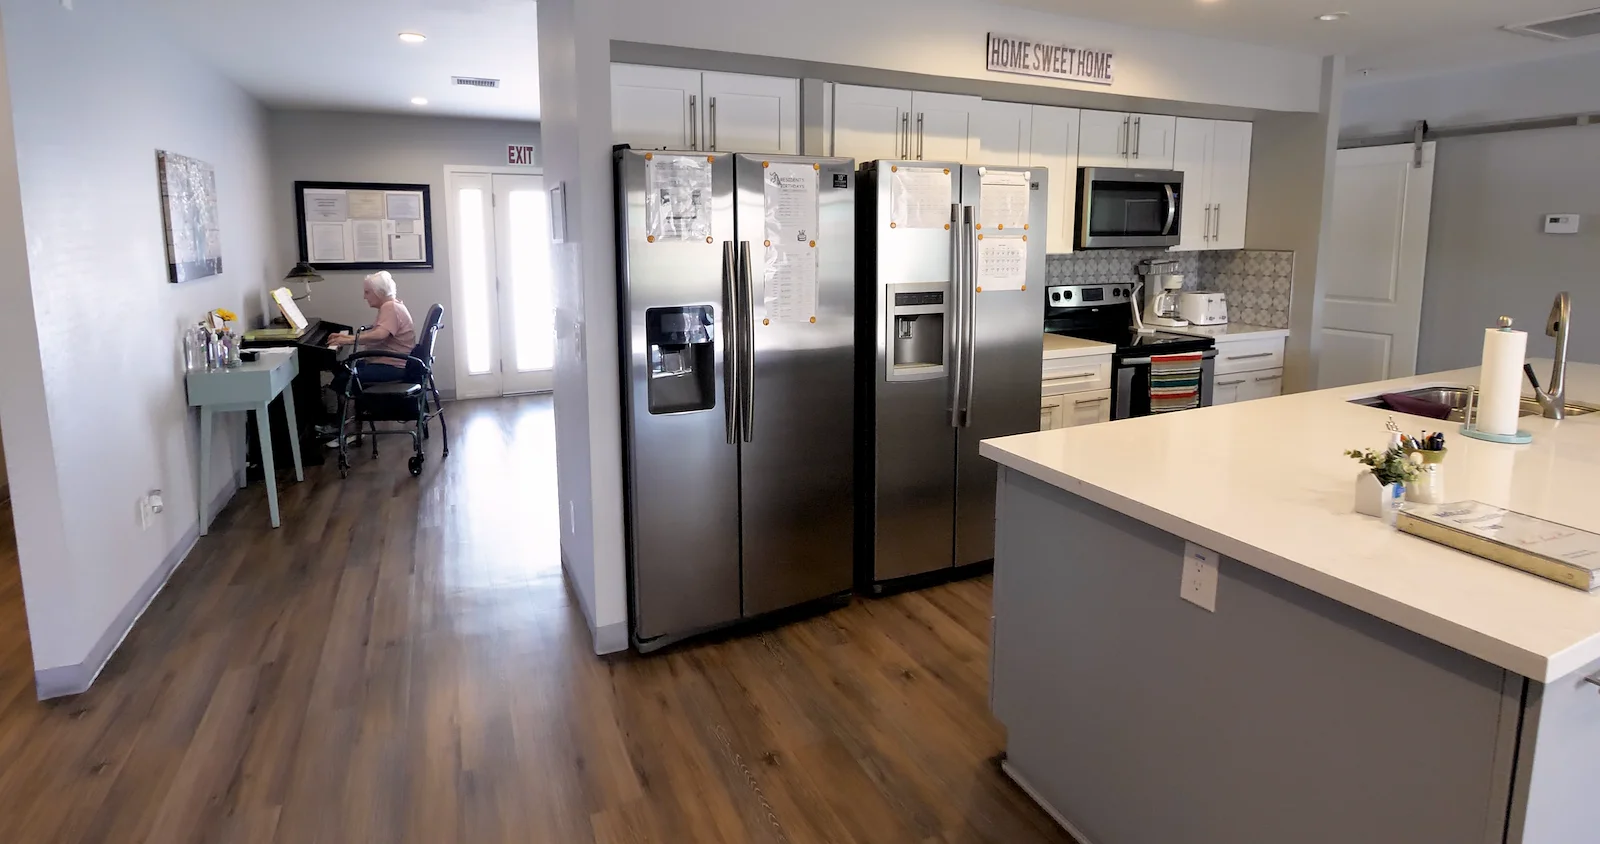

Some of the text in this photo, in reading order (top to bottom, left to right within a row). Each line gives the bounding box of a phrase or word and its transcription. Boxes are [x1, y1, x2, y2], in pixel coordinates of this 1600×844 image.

[991, 37, 1113, 79] HOME SWEET HOME
[508, 145, 533, 165] EXIT
